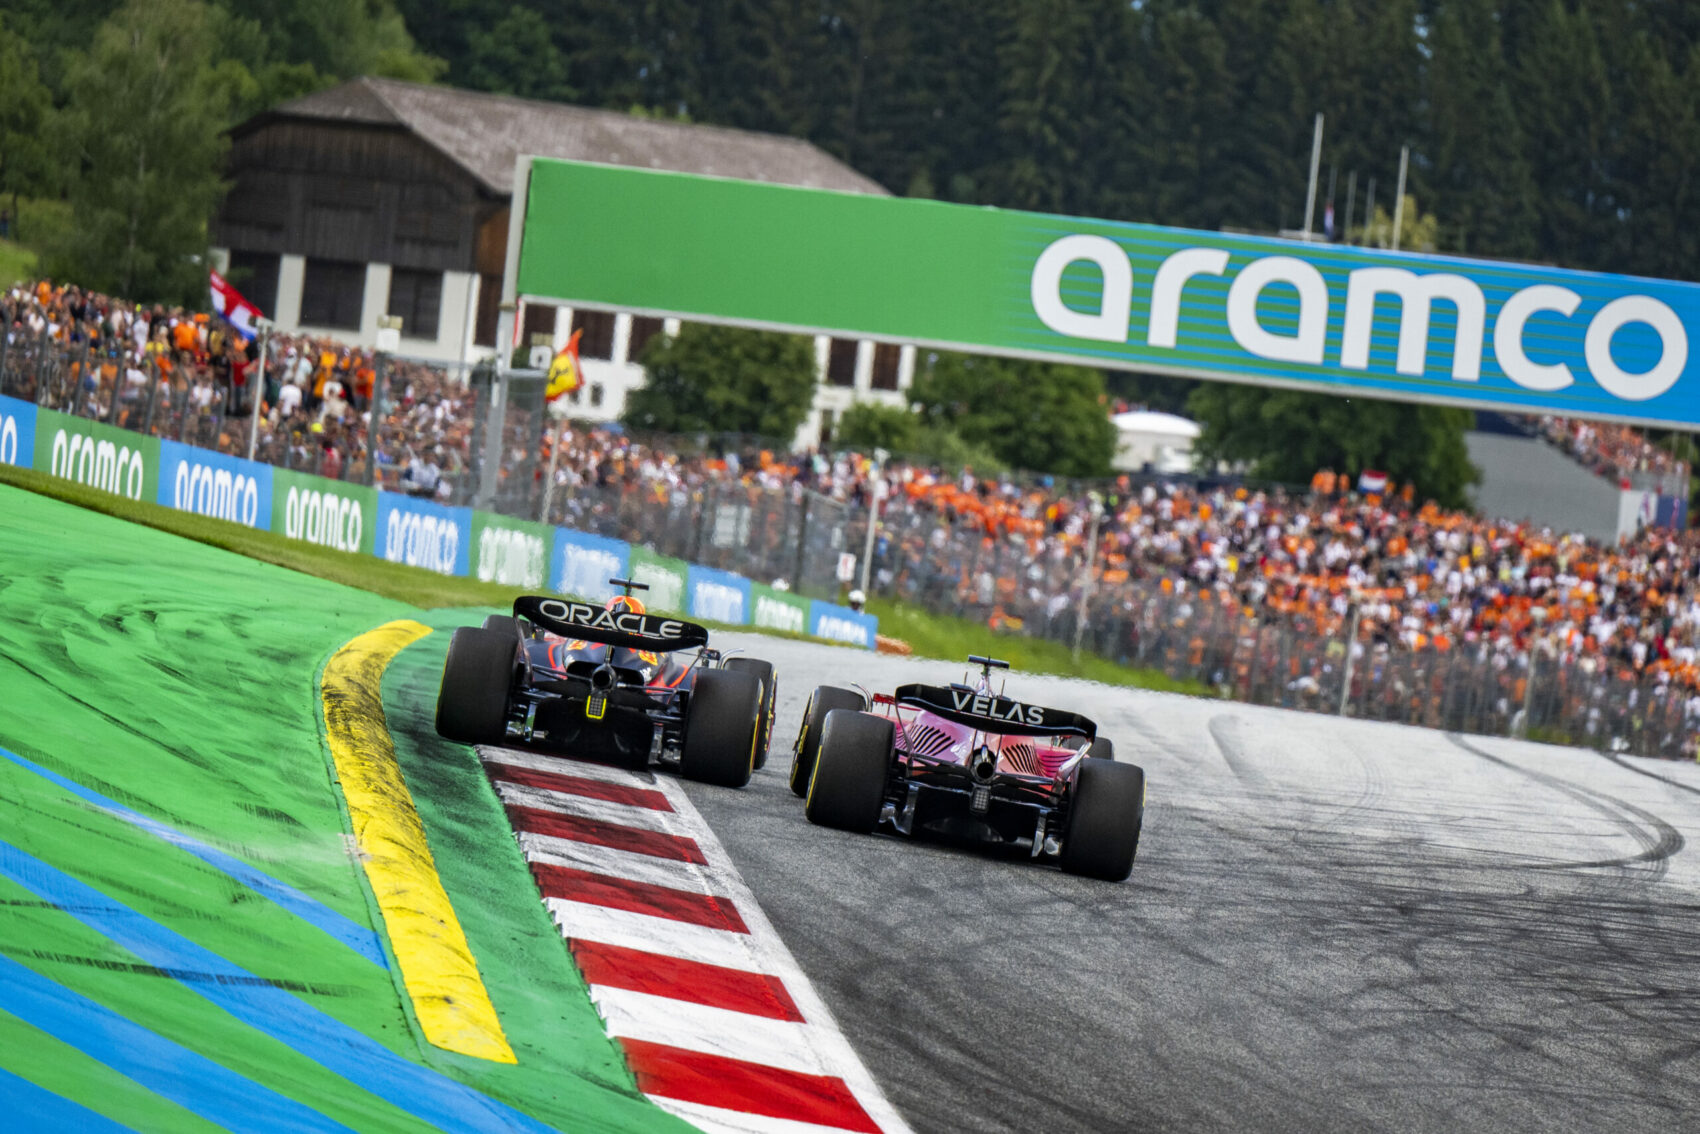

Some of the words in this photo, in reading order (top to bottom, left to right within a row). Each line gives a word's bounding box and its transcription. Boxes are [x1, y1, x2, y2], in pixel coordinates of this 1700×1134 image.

[1031, 234, 1688, 401] aramco
[52, 428, 143, 501] aramco
[175, 460, 258, 527] aramco
[285, 486, 362, 553] aramco
[384, 508, 459, 576] aramco
[539, 600, 684, 639] ORACLE
[952, 691, 1044, 725] VELAS
